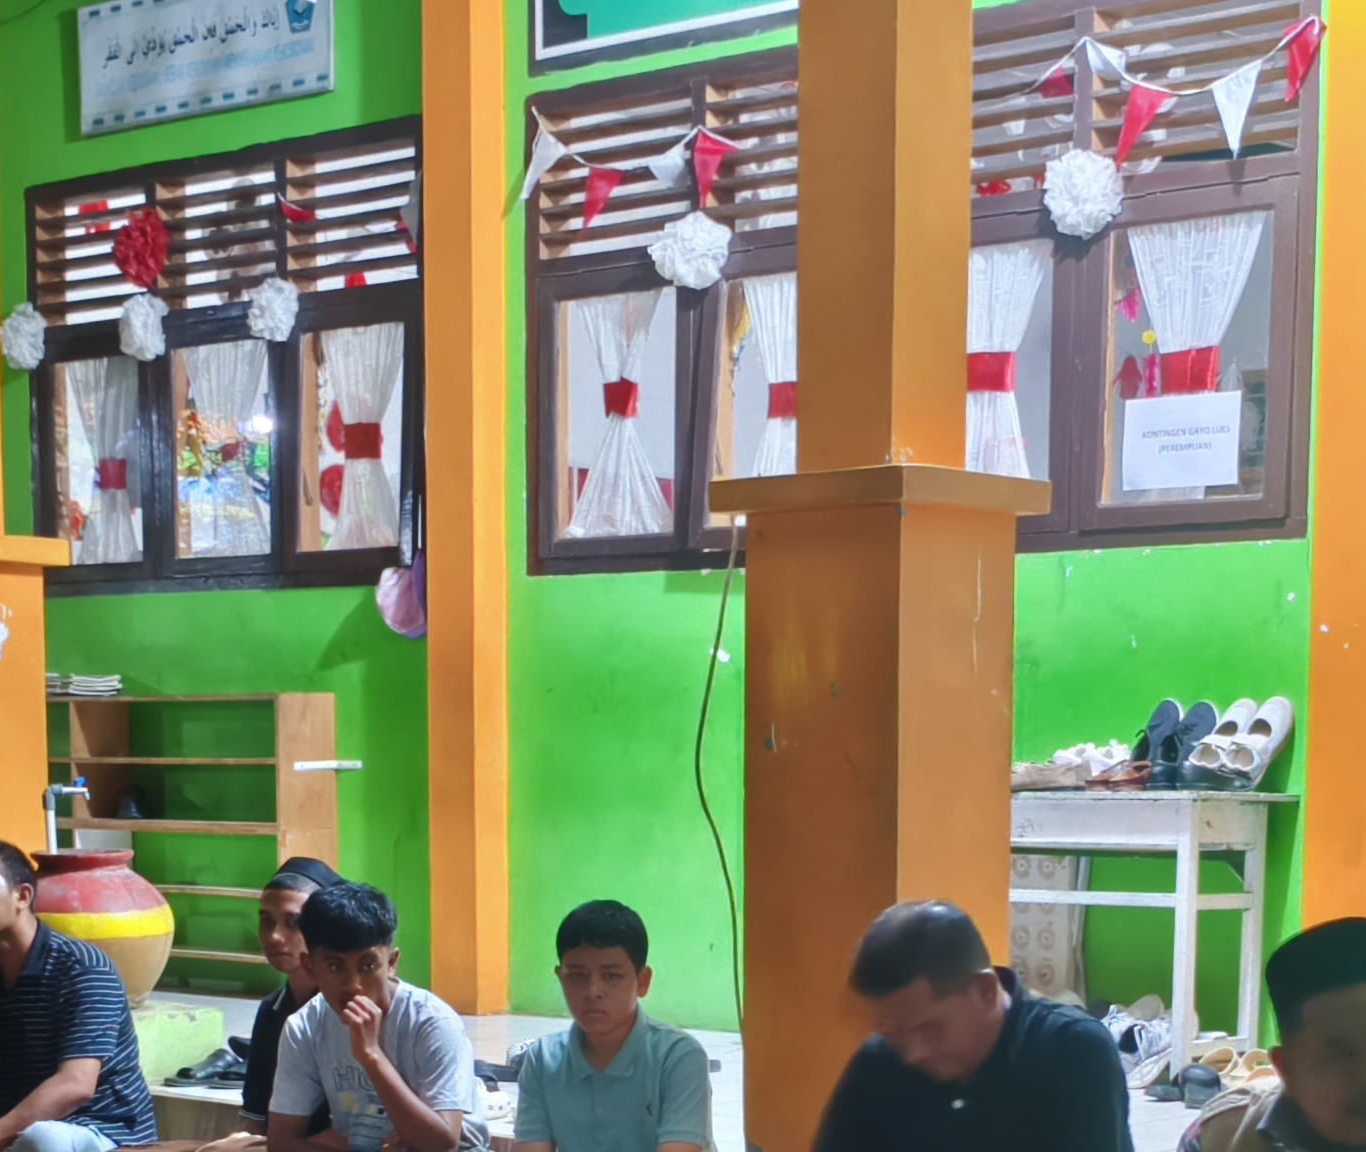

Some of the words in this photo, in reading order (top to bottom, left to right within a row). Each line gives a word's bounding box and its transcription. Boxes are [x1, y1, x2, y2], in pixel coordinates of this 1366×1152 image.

[1141, 428, 1187, 440] KONTINGEN
[1188, 426, 1210, 436] GAYO
[1158, 441, 1212, 454] (PEREMPUAN)
